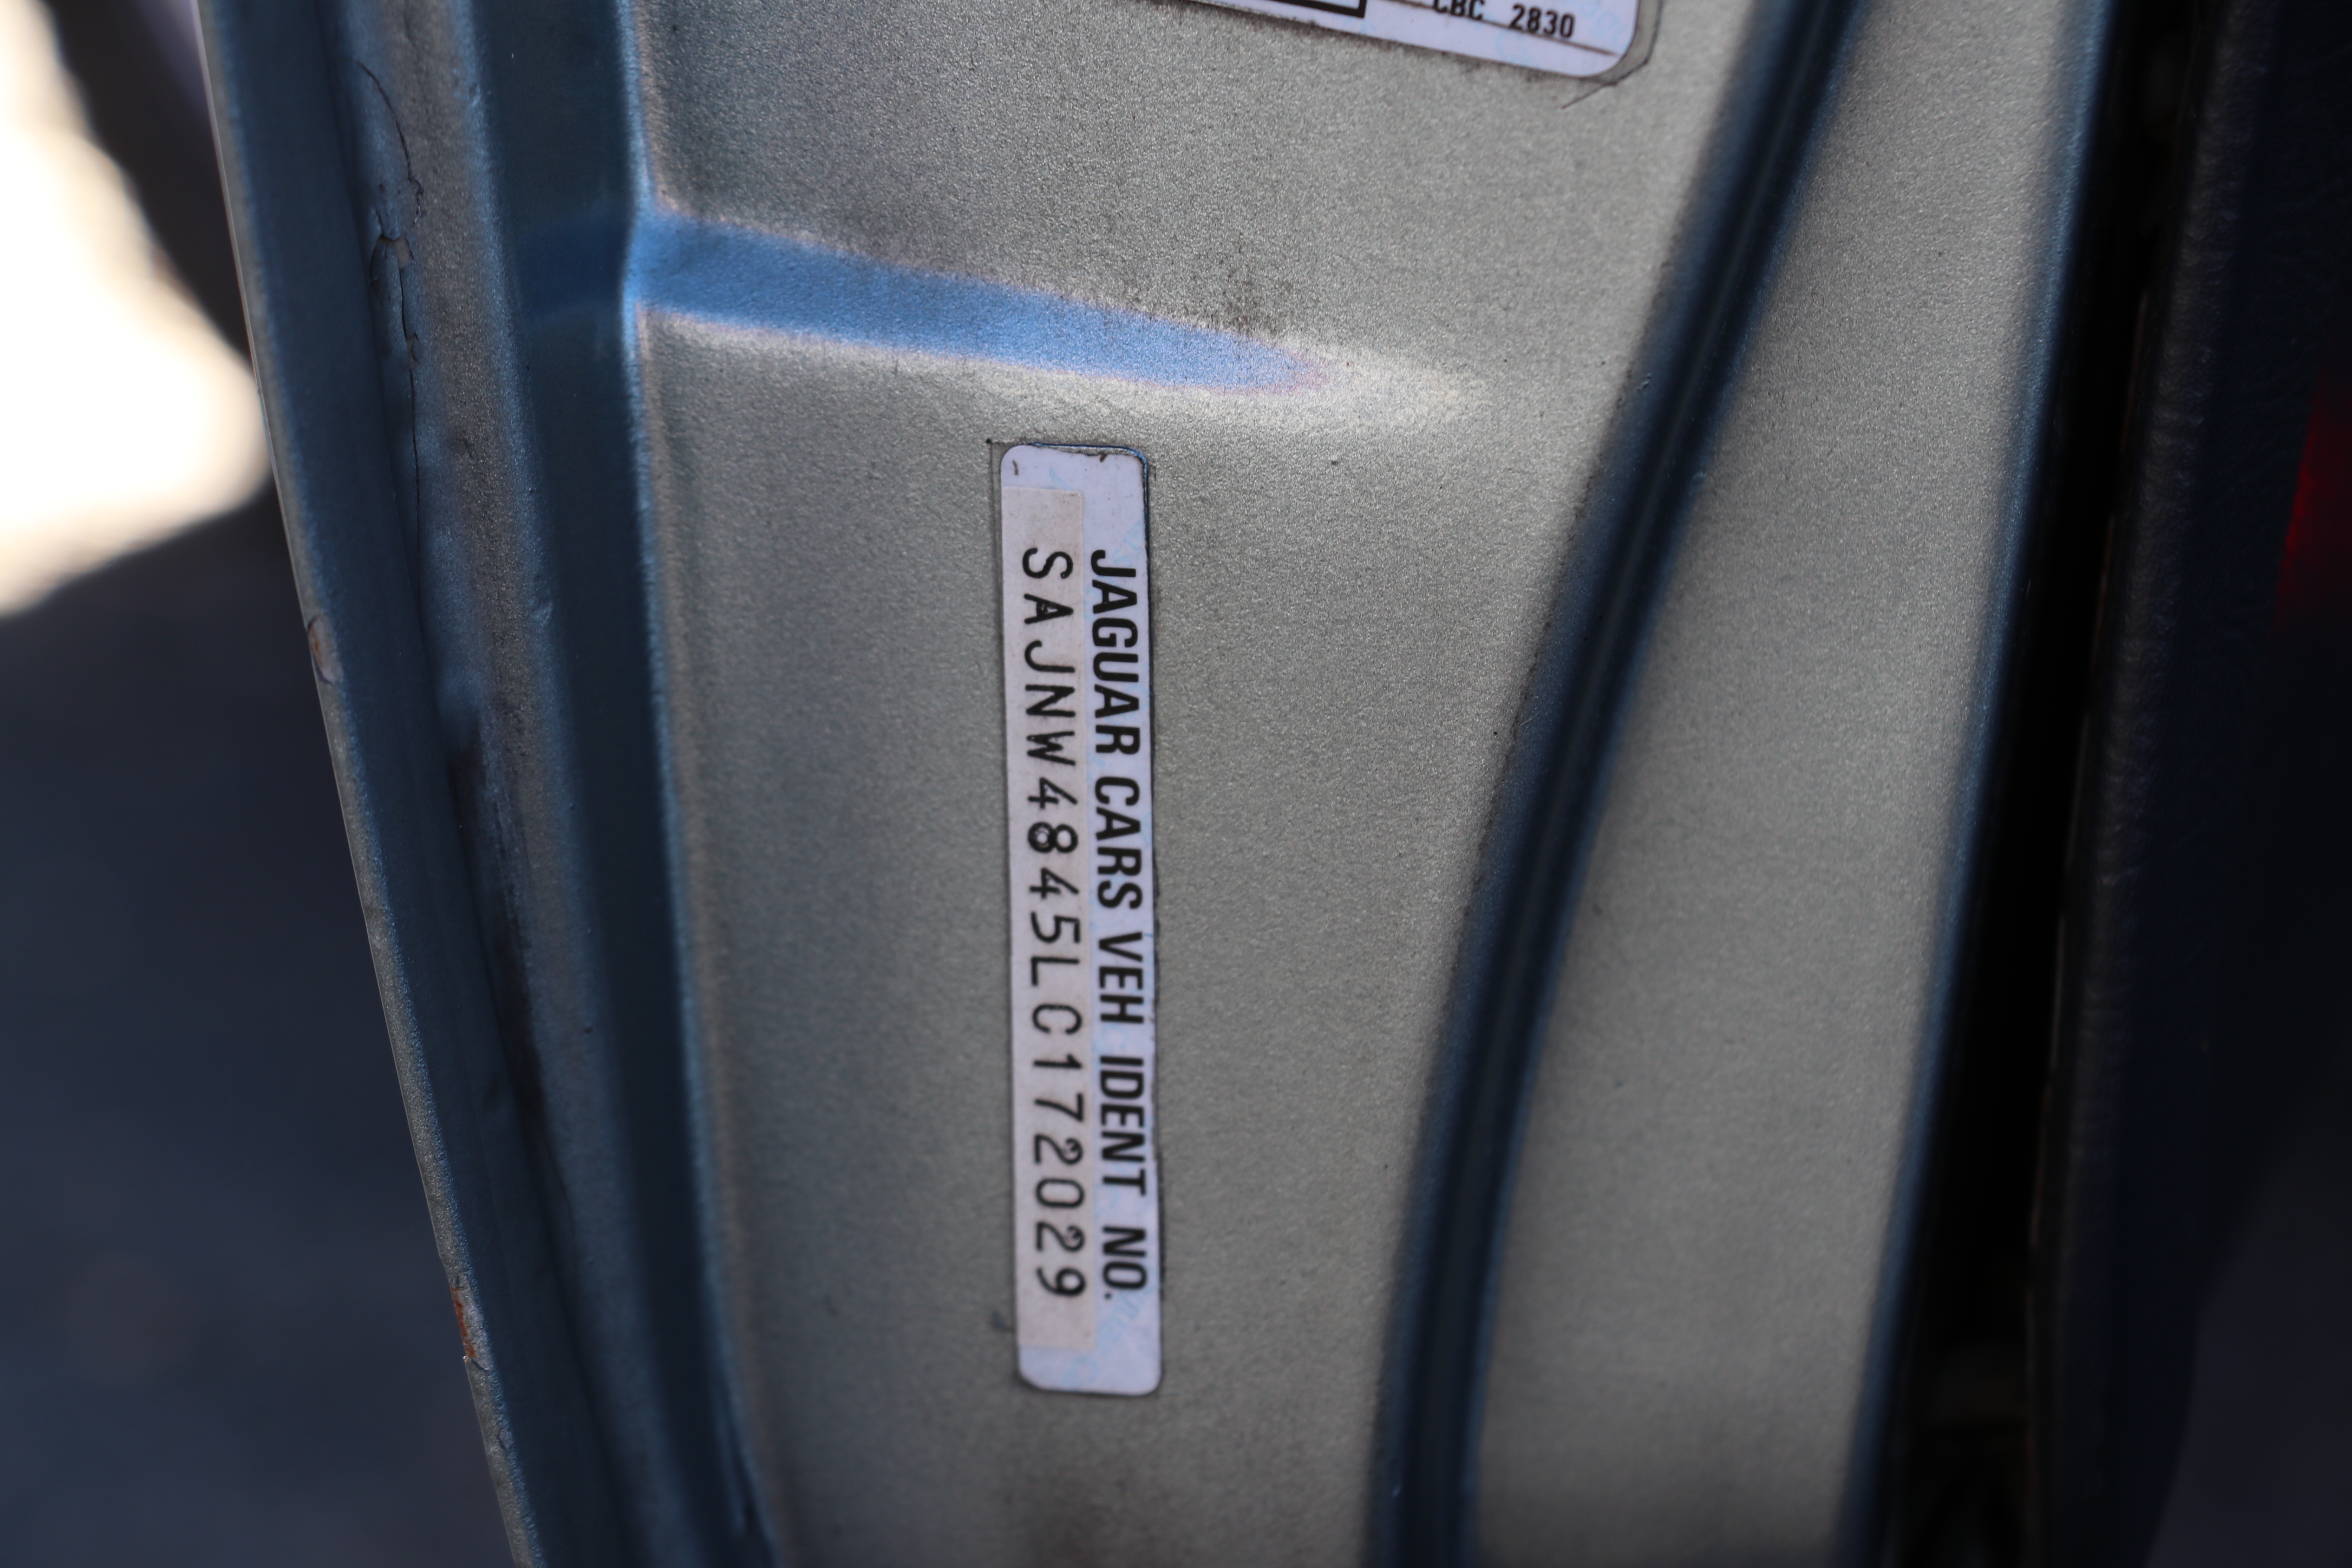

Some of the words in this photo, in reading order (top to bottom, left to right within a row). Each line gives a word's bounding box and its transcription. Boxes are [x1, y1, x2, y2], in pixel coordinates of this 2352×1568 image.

[1433, 0, 1485, 21] CBC
[1508, 3, 1576, 38] 2830
[1090, 548, 1141, 756] JAGUAR
[1094, 776, 1143, 910] CARS
[1021, 547, 1087, 1299] SAJNW4845LC172029
[1097, 931, 1144, 1025] VEH
[1099, 1055, 1146, 1196] IDENT
[1102, 1226, 1148, 1299] NO.
